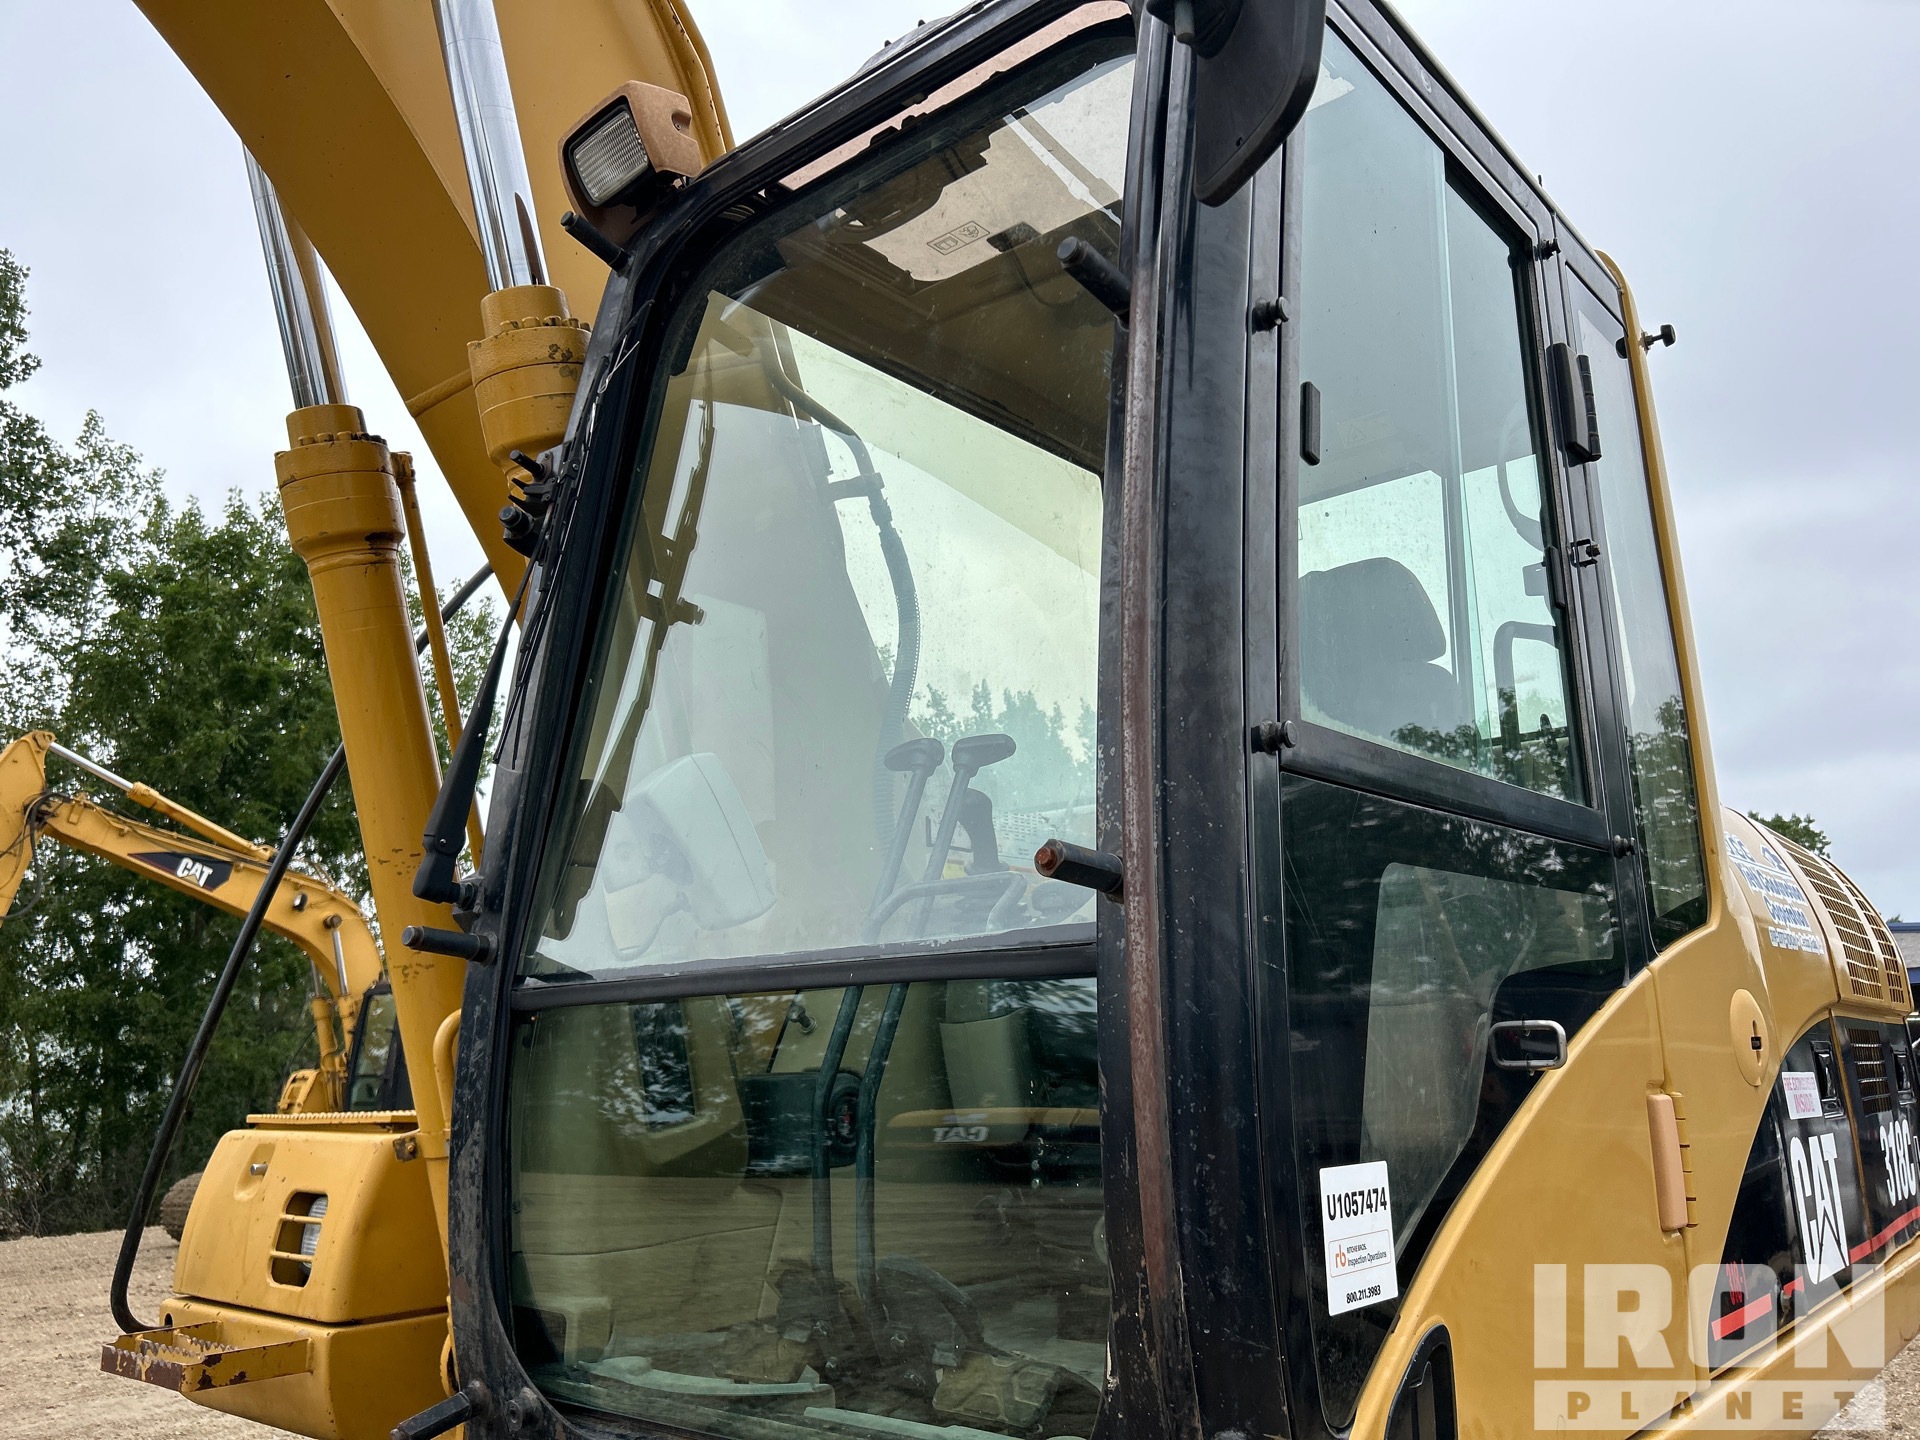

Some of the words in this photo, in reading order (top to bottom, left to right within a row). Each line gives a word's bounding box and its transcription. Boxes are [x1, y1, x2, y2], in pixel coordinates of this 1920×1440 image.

[177, 857, 213, 888] CAT
[1327, 1187, 1387, 1221] U1057474
[1790, 1133, 1849, 1284] CAT
[1347, 1255, 1367, 1267] Inspection
[1367, 1251, 1387, 1264] Operations
[1346, 1284, 1381, 1304] 800.211.3983
